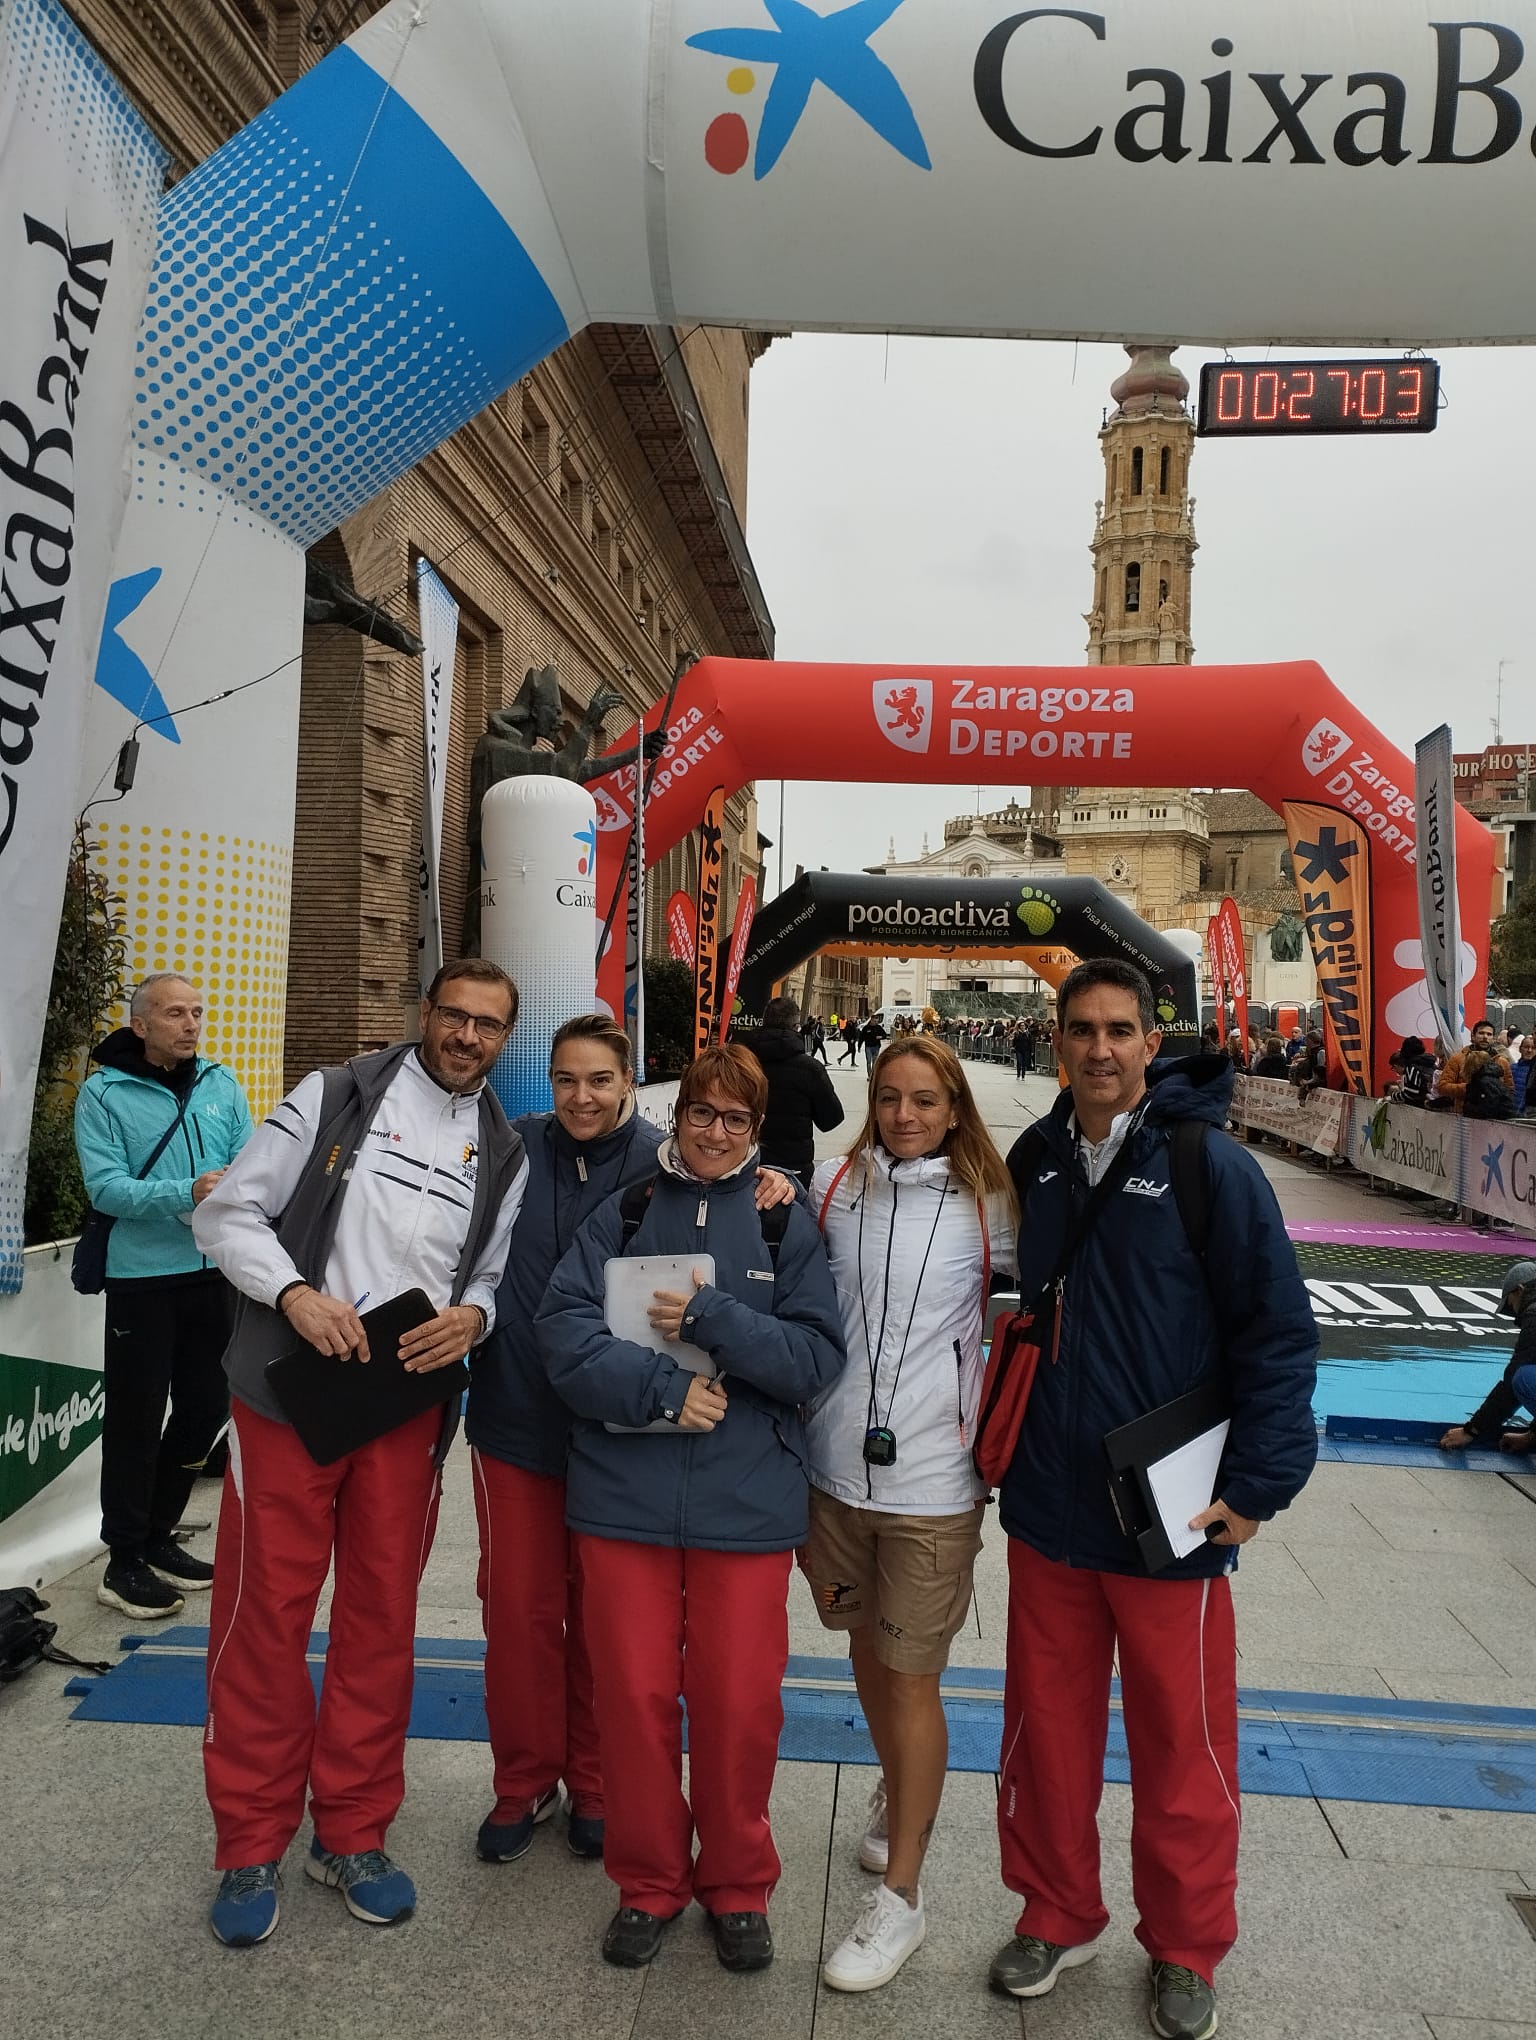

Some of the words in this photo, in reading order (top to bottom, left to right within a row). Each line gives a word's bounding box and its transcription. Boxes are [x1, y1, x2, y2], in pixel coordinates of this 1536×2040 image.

[973, 8, 1536, 166] CaixaB
[1218, 369, 1422, 420] 00:27:03
[952, 680, 1134, 722] Zaragoza
[949, 718, 1133, 758] DEPORTE
[1349, 752, 1416, 823] Zarago
[741, 954, 759, 970] Pisa
[757, 938, 780, 956] bien,
[777, 923, 794, 939] vive
[793, 902, 817, 926] mejor
[849, 899, 1010, 932] podoactiva
[1082, 905, 1101, 926] Pisa
[1100, 922, 1120, 944] bien,
[1121, 939, 1138, 956] vive
[1137, 952, 1165, 975] mejor
[1382, 1128, 1447, 1178] CaixaBank
[879, 1617, 904, 1640] JUEZ
